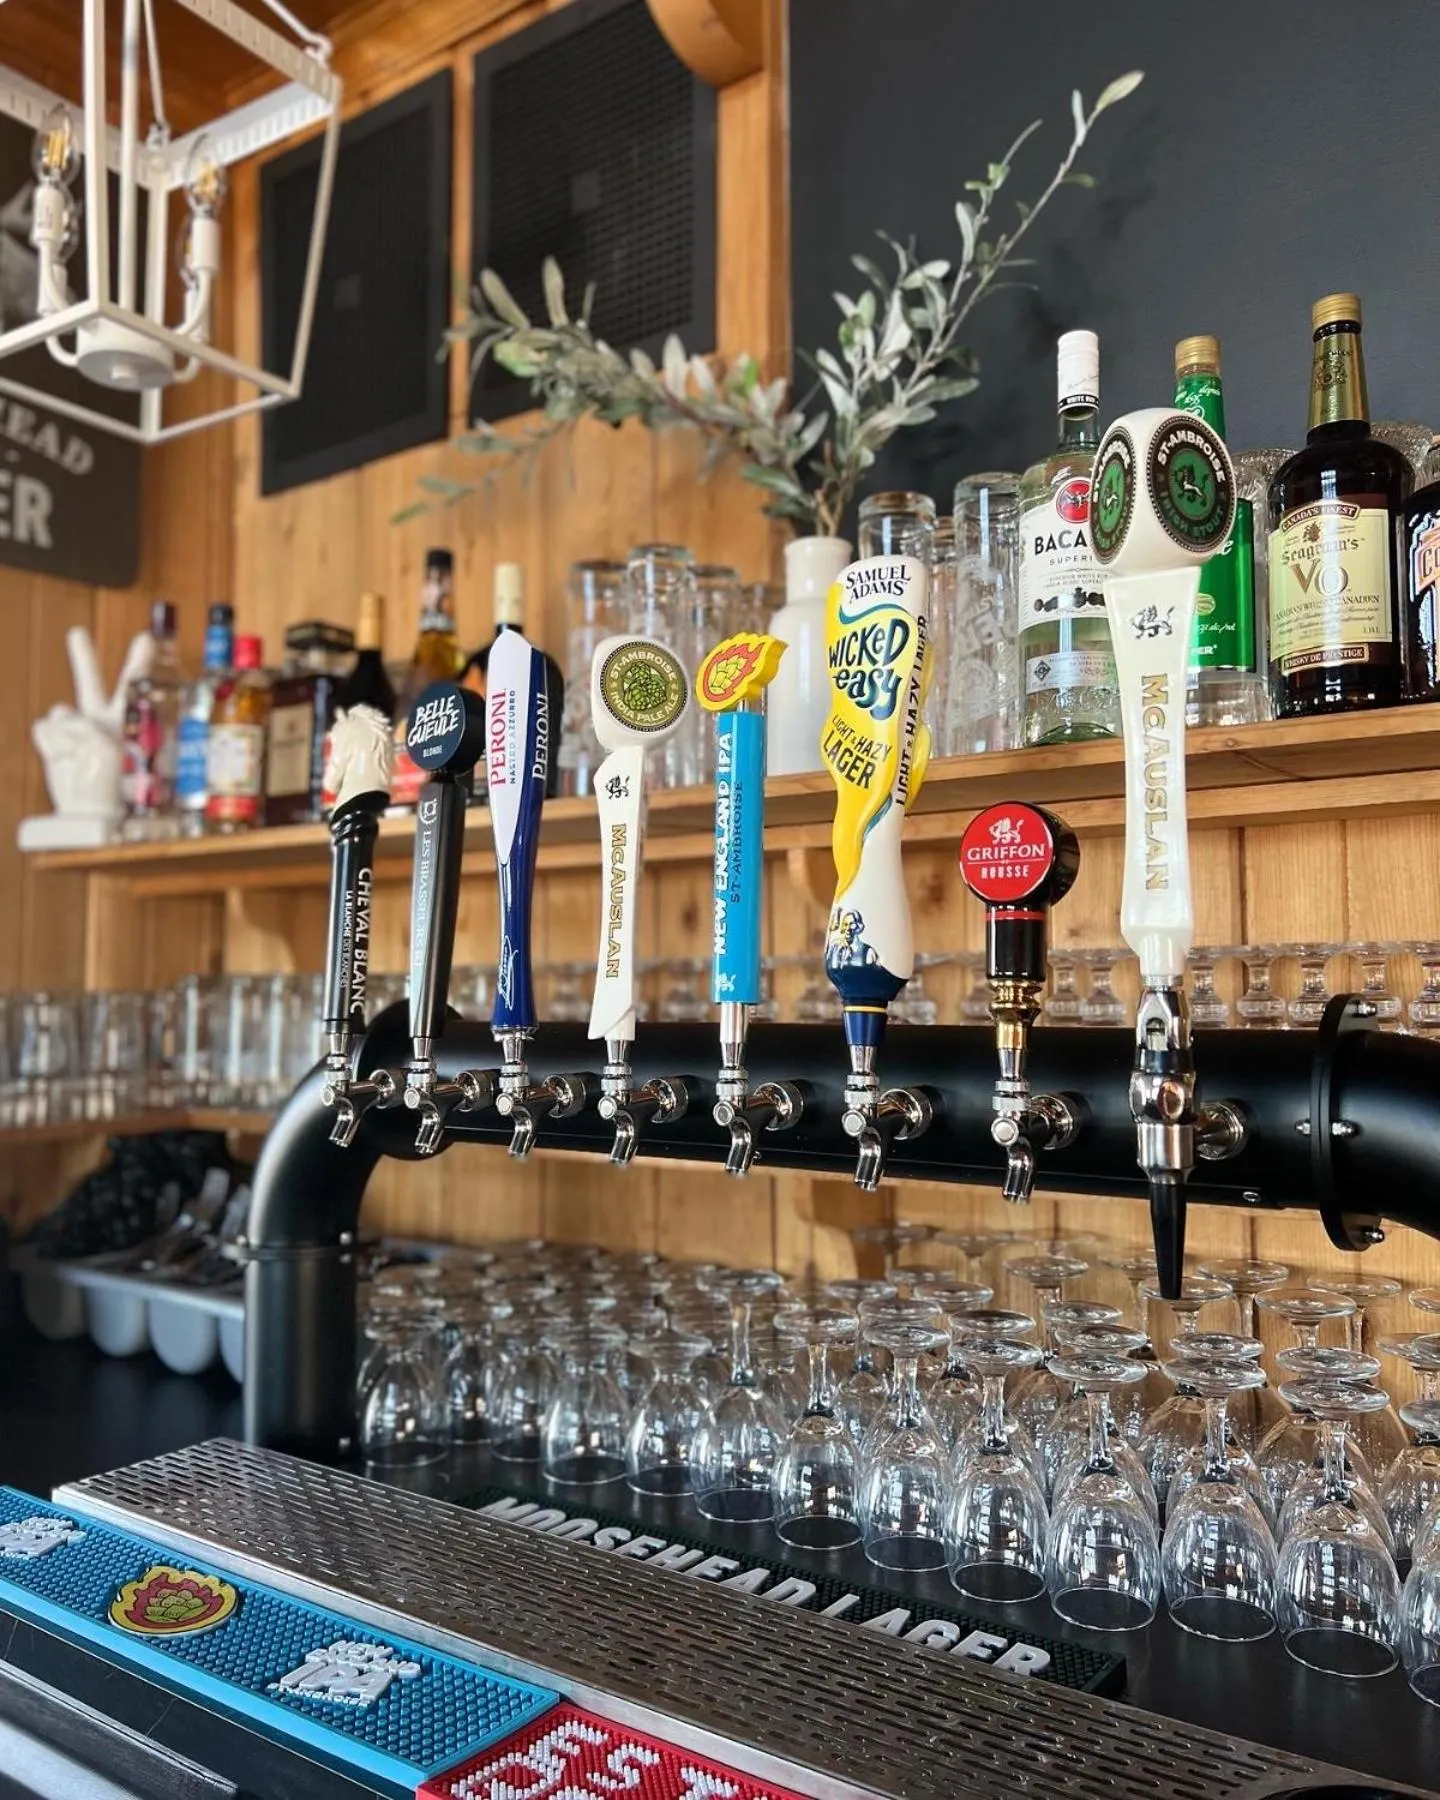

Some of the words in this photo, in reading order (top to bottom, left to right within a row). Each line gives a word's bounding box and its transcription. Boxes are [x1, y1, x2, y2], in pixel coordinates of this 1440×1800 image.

[1157, 430, 1226, 483] ST-AMBROISE
[1034, 529, 1088, 555] BACA
[1050, 555, 1093, 566] SUPERI
[845, 565, 912, 589] SAMUEL
[849, 581, 906, 604] ADAMS
[610, 651, 677, 681] ST-AMBROISE
[1311, 653, 1321, 662] DE
[416, 695, 456, 724] BELLE
[610, 691, 635, 718] INDIA
[636, 711, 665, 722] PALE
[664, 692, 679, 714] ALE
[832, 667, 903, 720] easy
[407, 709, 460, 747] GUEULE
[490, 691, 506, 787] PERONI
[532, 692, 549, 780] PERONI
[832, 713, 855, 741] LIGHT
[854, 736, 893, 763] HAZY
[718, 732, 732, 773] IPA
[823, 729, 876, 789] LAGER
[715, 780, 732, 891] ENGLAND
[730, 781, 743, 903] ST-AMBROISE
[967, 844, 1045, 860] GRIFFON
[981, 865, 1030, 879] ROUSSE
[354, 867, 373, 942] CHEVAL
[713, 898, 728, 954] NEW
[351, 950, 369, 1014] BLANC
[820, 1593, 1050, 1677] LAGER
